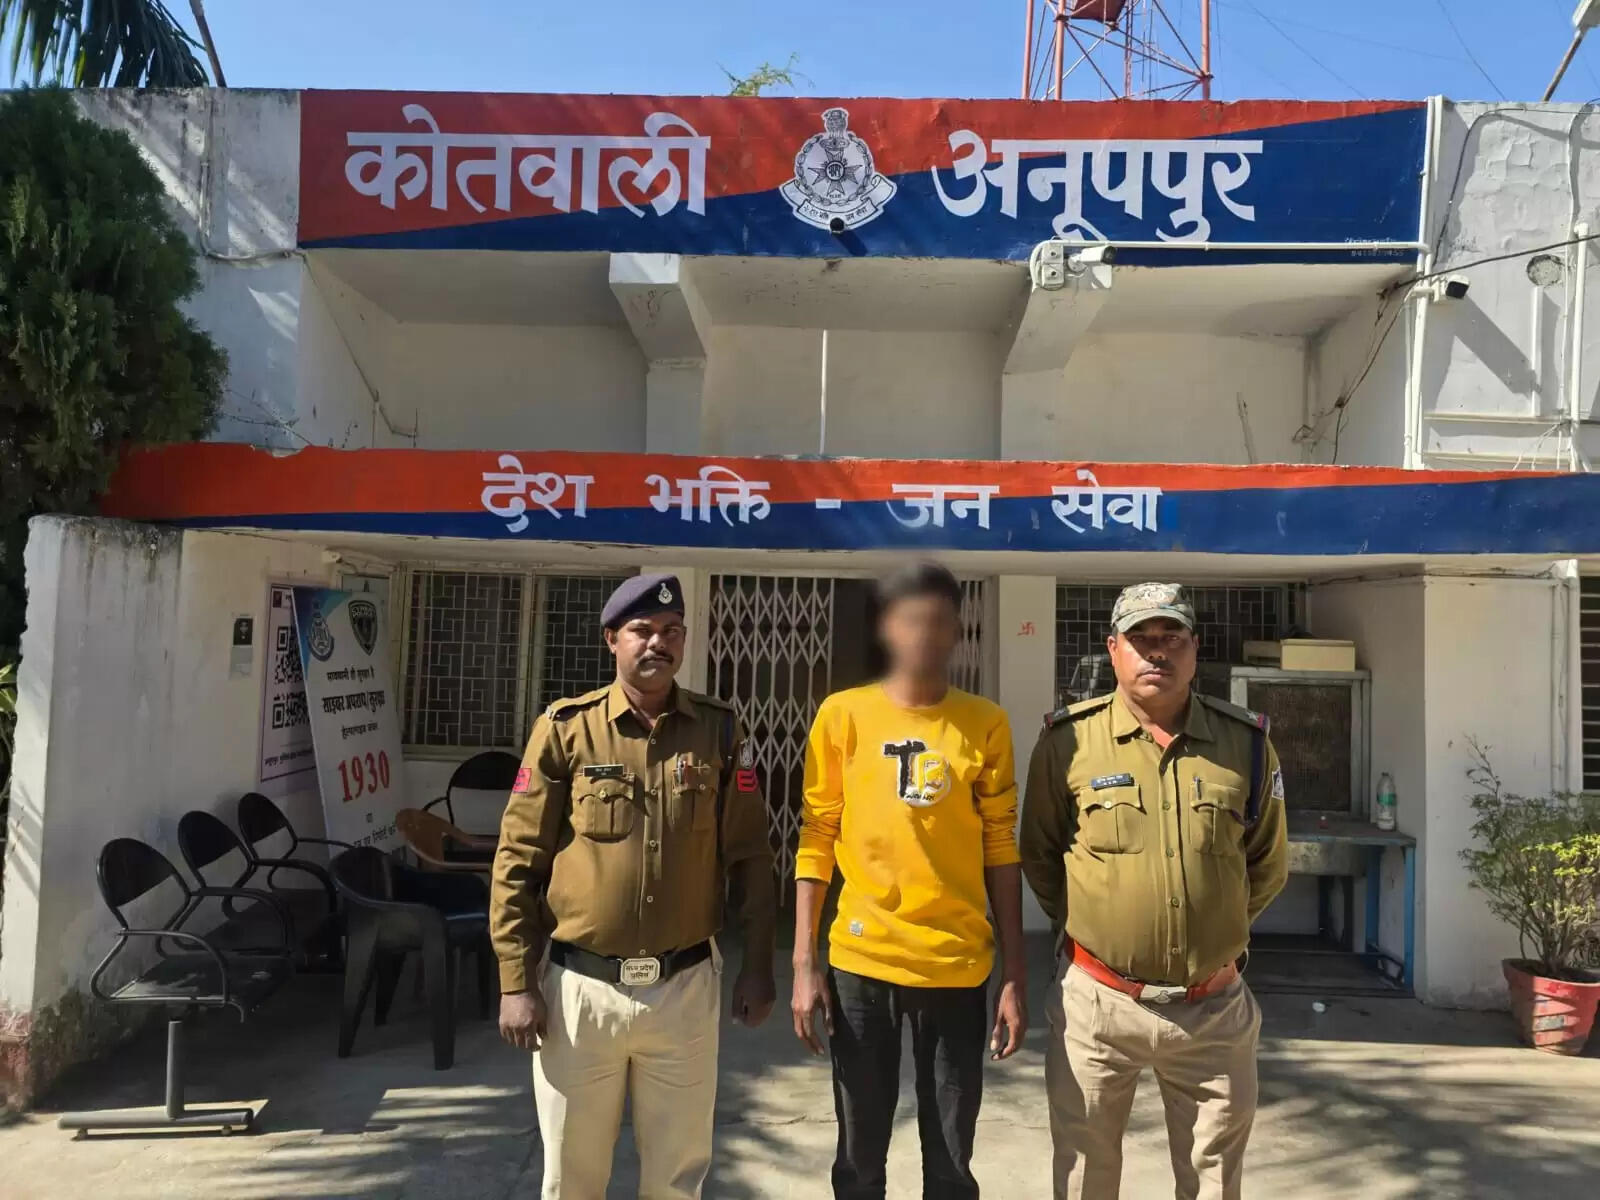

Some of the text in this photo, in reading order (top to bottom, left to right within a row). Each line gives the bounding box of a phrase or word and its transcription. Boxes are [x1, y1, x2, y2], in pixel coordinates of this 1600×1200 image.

[344, 103, 1263, 242] कोतवाली अनूपपुर
[480, 454, 595, 533] देश
[644, 465, 771, 527] भक्ति
[886, 484, 1000, 529] जन
[1051, 469, 1163, 533] सेवा
[338, 750, 390, 802] 1930
